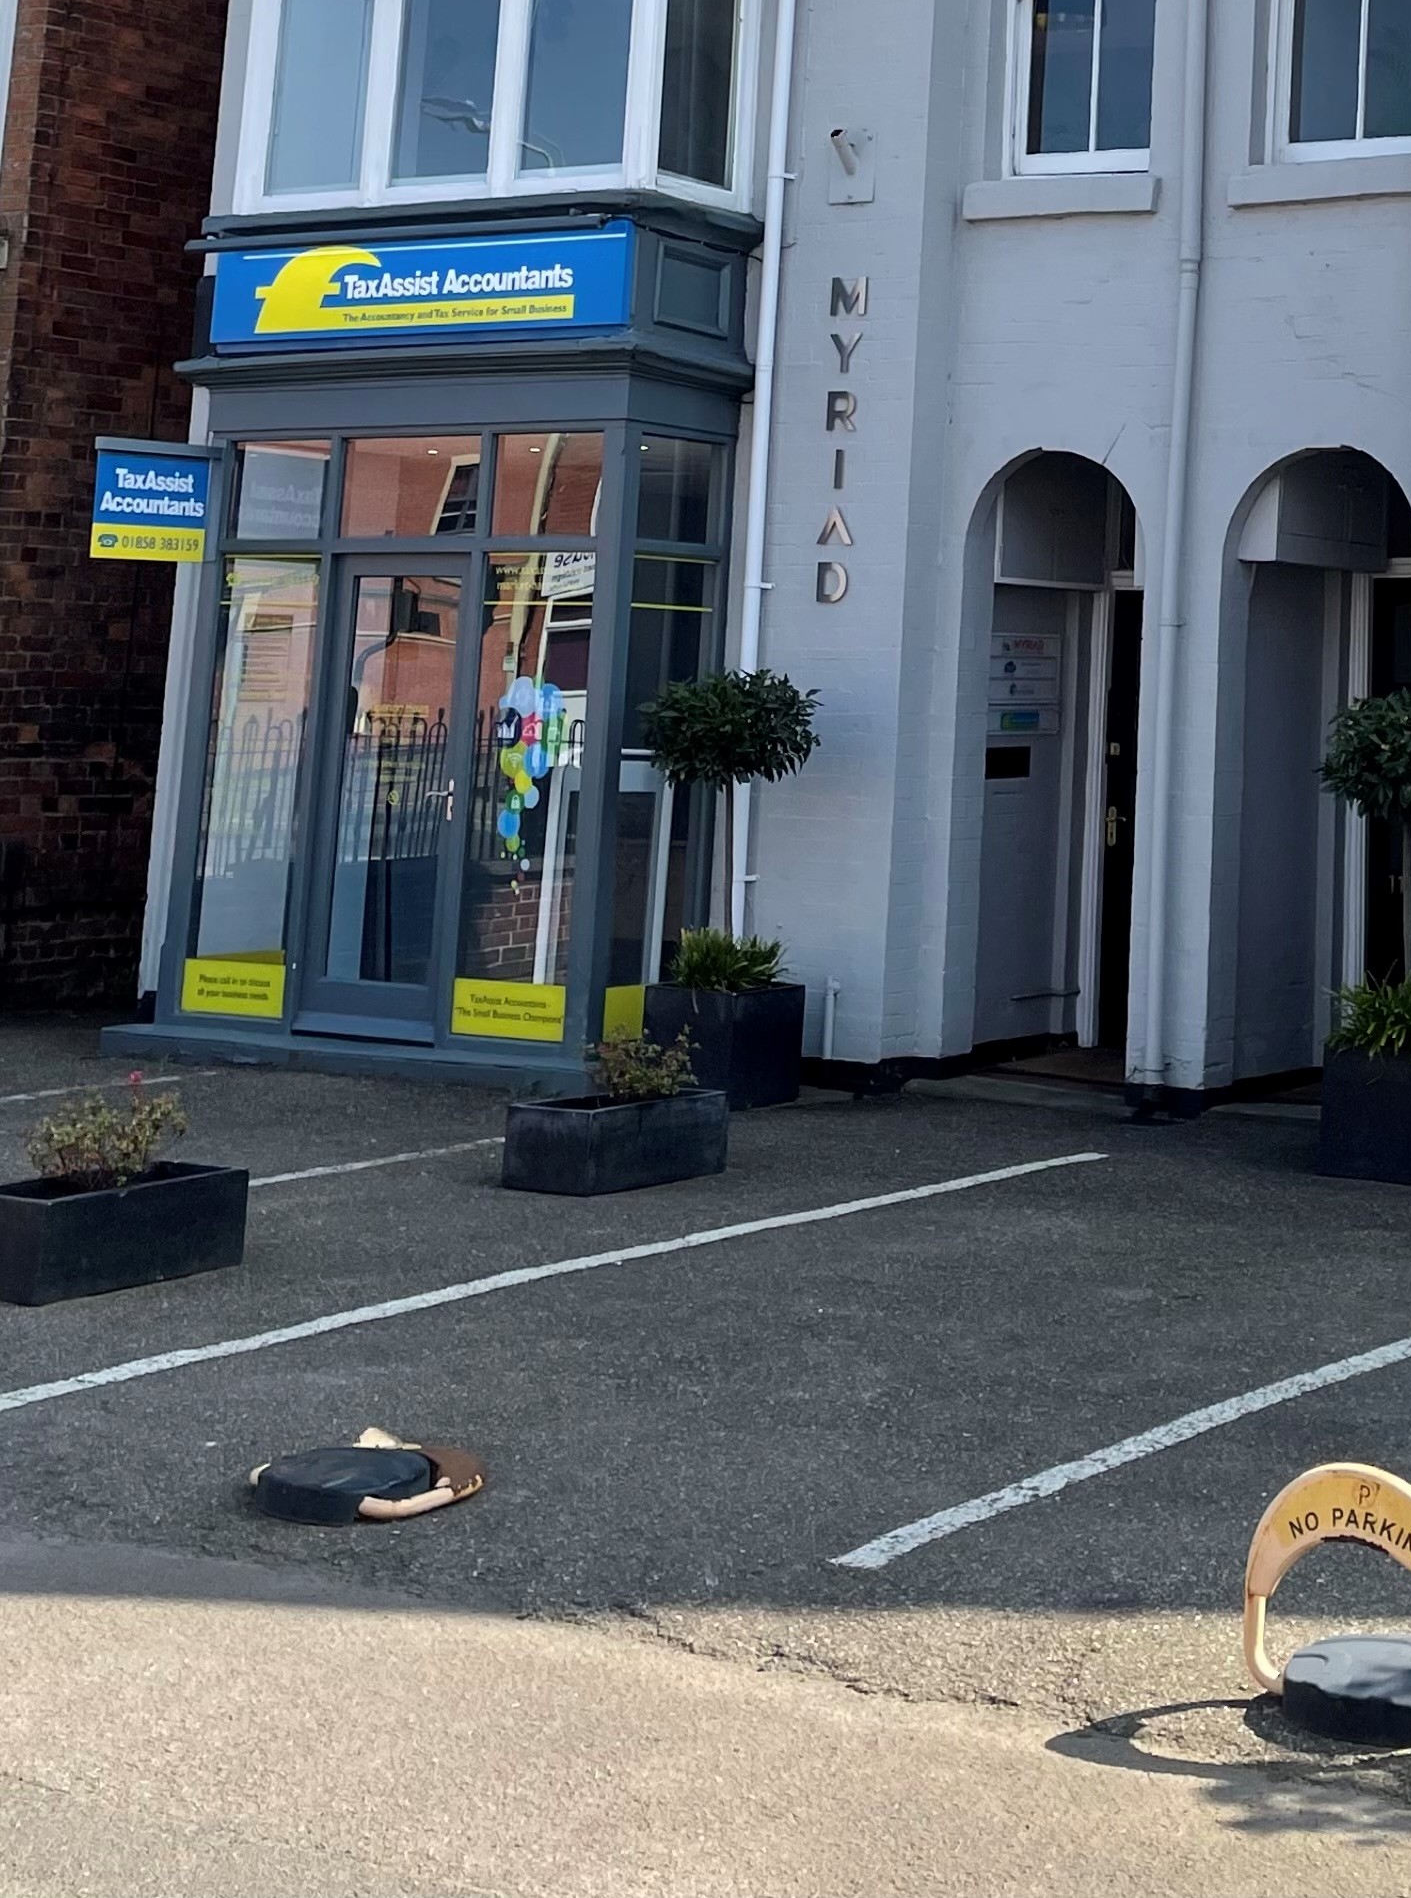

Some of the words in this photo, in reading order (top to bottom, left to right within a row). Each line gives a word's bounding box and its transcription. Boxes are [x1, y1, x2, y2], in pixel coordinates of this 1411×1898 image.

[343, 270, 439, 300] TaxAssist
[442, 263, 574, 295] Accountants
[342, 313, 359, 323] The
[360, 311, 415, 323] Accountancy
[417, 309, 433, 320] and
[434, 309, 449, 319] Tax
[451, 307, 484, 318] Service
[486, 305, 499, 316] for
[501, 304, 527, 315] Small
[529, 303, 567, 314] Business
[815, 275, 869, 603] MYRIAD
[115, 467, 195, 493] TaxAssist
[100, 490, 205, 518] Accountants
[121, 535, 157, 550] 01858
[1288, 1511, 1320, 1540] NO
